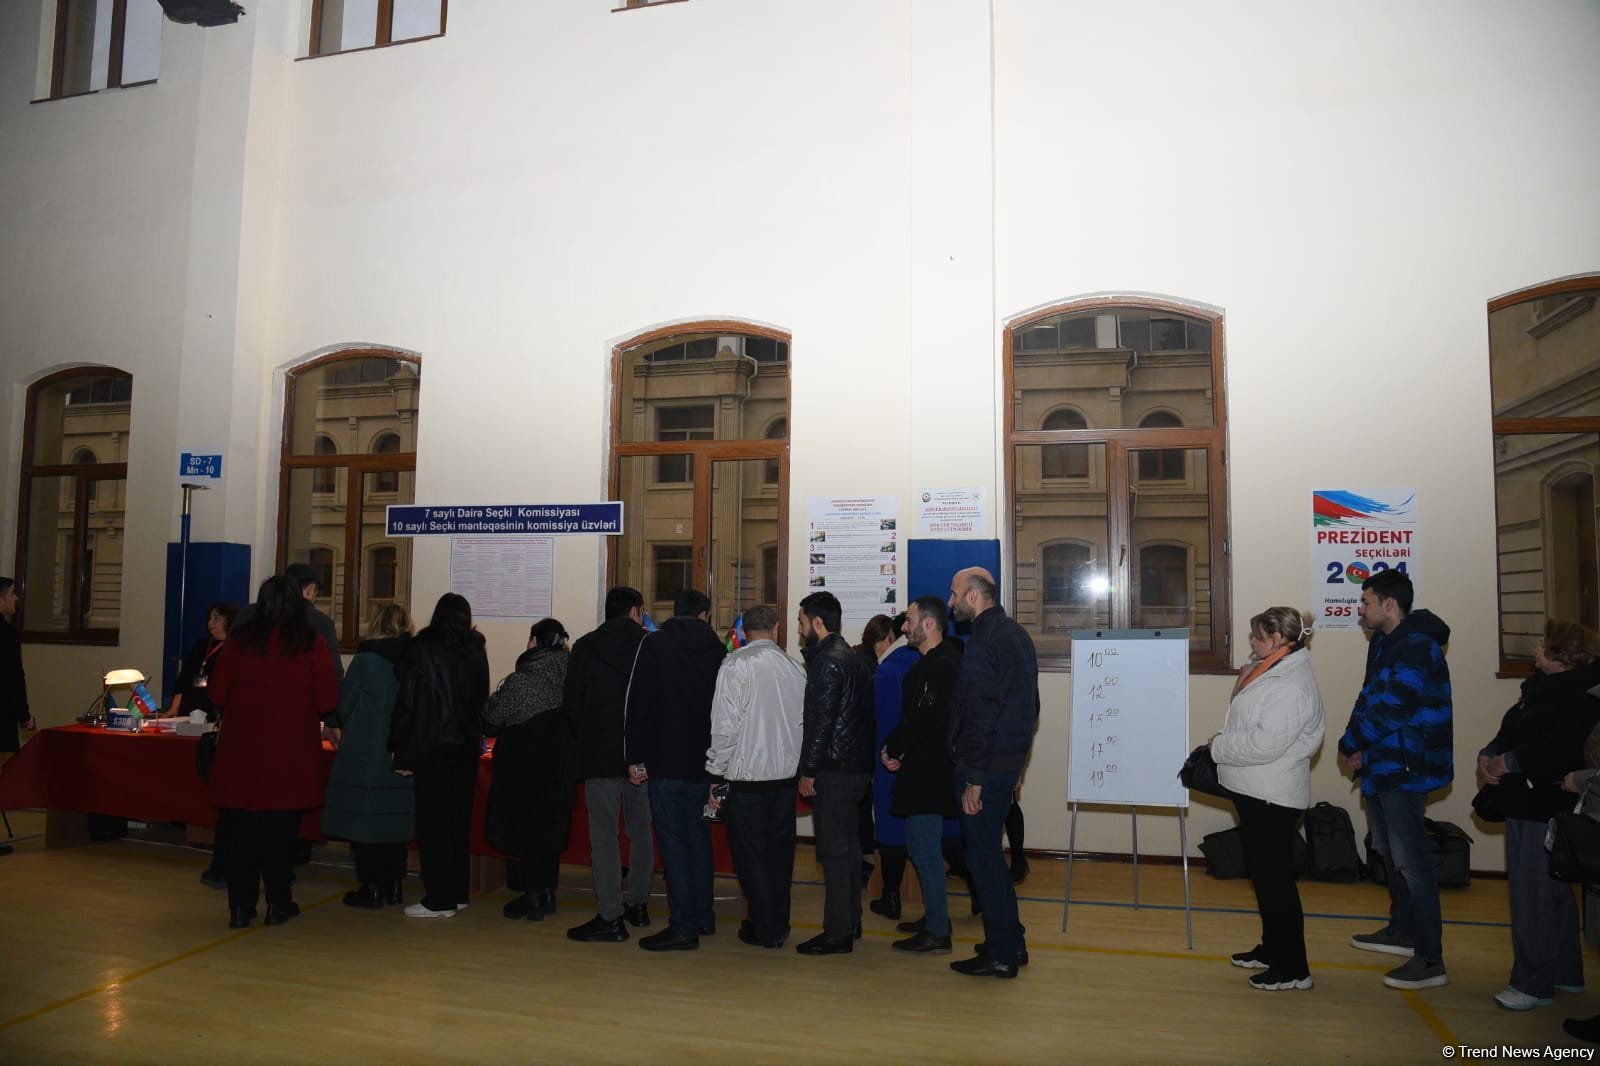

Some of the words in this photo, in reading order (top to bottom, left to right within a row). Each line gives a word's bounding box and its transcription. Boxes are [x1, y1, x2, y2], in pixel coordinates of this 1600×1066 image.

[190, 457, 201, 465] SD
[208, 457, 213, 465] 7
[187, 466, 199, 474] Mn
[206, 466, 215, 474] 10
[425, 509, 430, 518] 7
[433, 509, 455, 520] saylı
[457, 508, 483, 518] Dairə
[485, 508, 512, 519] Seçki
[518, 507, 580, 519] Komissiyası
[393, 522, 403, 531] 10
[405, 521, 427, 533] saylı
[429, 521, 456, 532] Seçki
[458, 520, 524, 532] məntəqəsinin
[527, 520, 579, 532] komissiya
[581, 520, 616, 530] üzvləri
[890, 532, 897, 540] 2
[1317, 527, 1413, 544] PREZİDENT
[809, 544, 815, 552] 3
[1355, 547, 1411, 560] SEÇKİLƏRİ
[809, 566, 815, 574] 5
[890, 577, 897, 585] 6
[890, 607, 897, 615] 8
